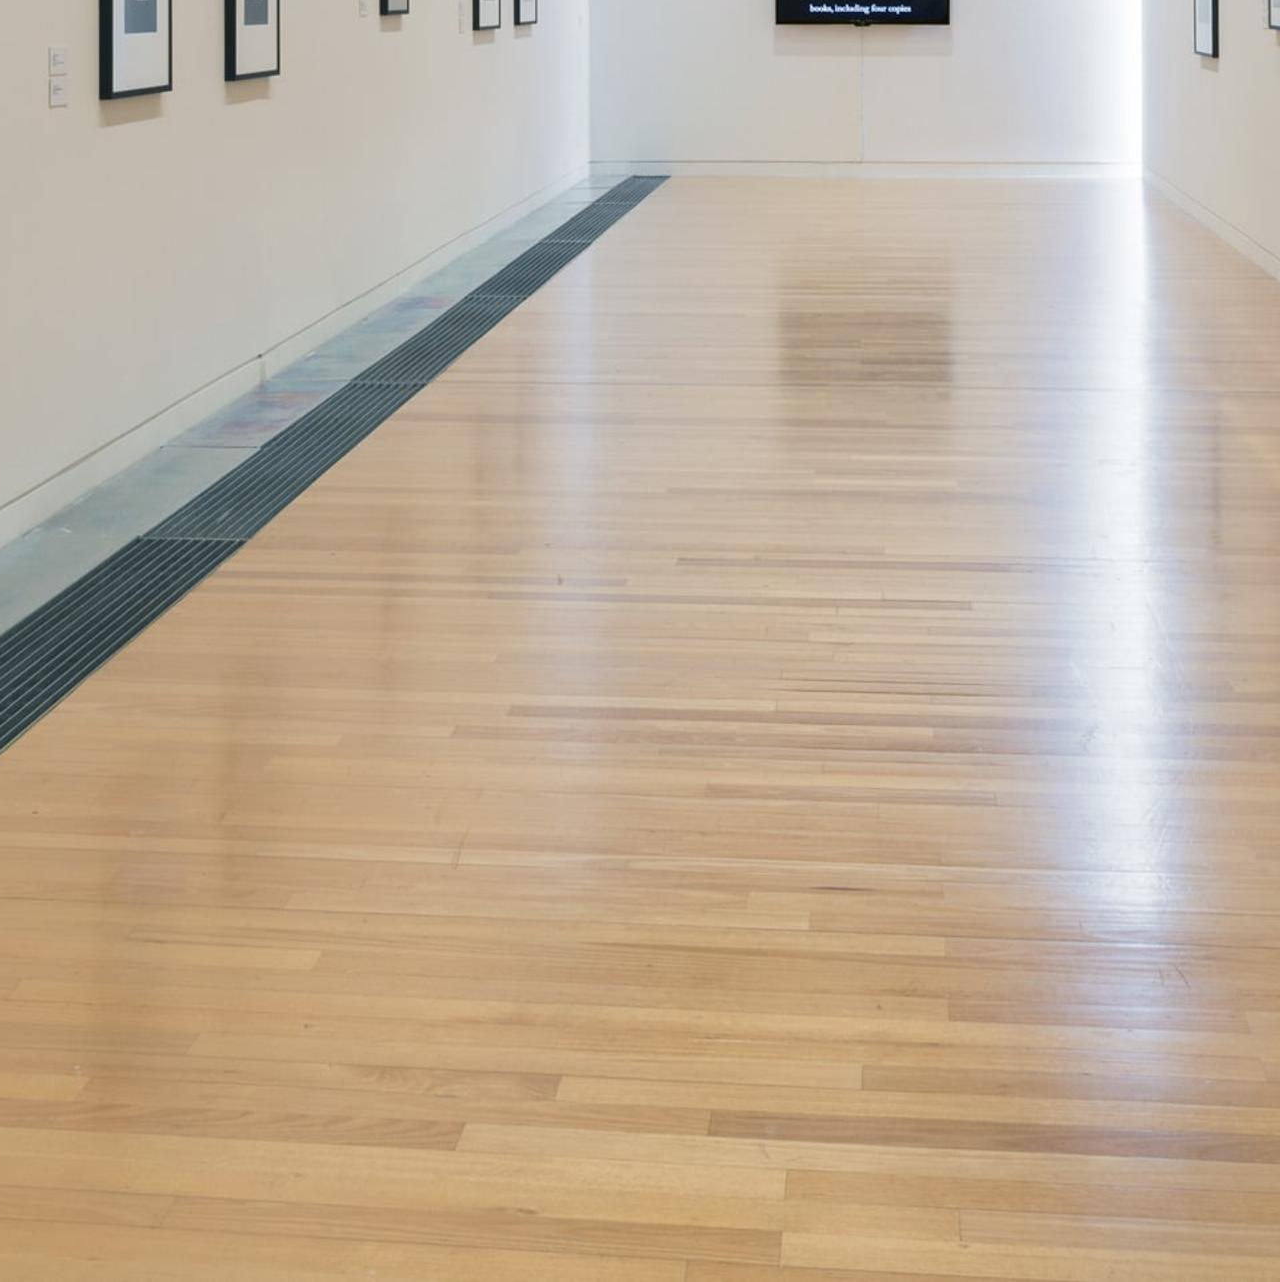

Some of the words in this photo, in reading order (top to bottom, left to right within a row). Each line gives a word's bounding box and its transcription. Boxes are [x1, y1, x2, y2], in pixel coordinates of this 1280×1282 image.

[809, 3, 834, 14] books,
[834, 3, 870, 14] including
[871, 4, 886, 13] four
[887, 4, 911, 14] copies
